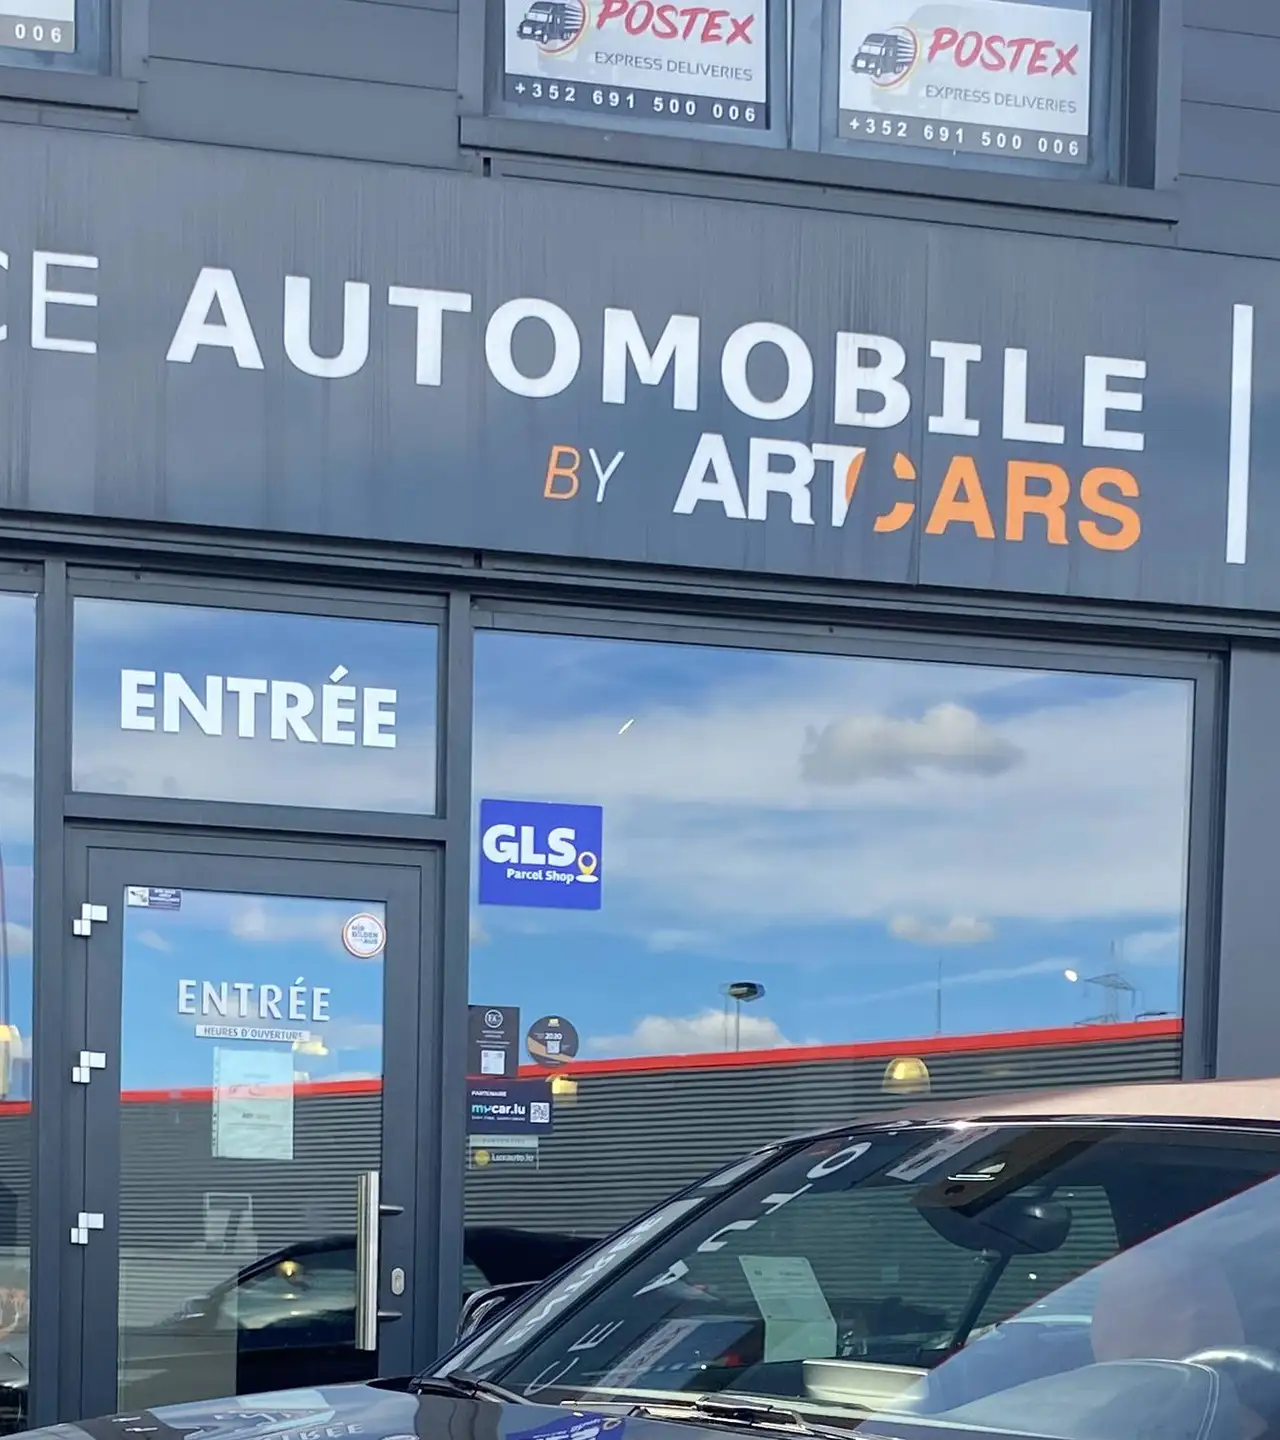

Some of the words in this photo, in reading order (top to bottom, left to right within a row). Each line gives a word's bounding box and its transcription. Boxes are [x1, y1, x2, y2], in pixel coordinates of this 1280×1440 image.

[15, 23, 61, 43] 006
[596, 0, 754, 45] POSTEX
[595, 51, 662, 71] EXPRESS
[667, 59, 753, 81] DELIVERIES
[927, 27, 1079, 77] POSTEX
[515, 82, 575, 101] +352
[593, 90, 635, 108] 691
[653, 97, 695, 115] 500
[713, 104, 755, 122] 006
[926, 84, 990, 104] EXPRESS
[995, 93, 1077, 113] DELIVERIES
[850, 118, 907, 137] +352
[924, 125, 963, 143] 691
[982, 132, 1021, 149] 500
[1038, 138, 1078, 155] 006
[166, 266, 1148, 451] AUTOMOBILE
[544, 444, 625, 504] BY
[672, 432, 1142, 552] ARTCARS
[121, 664, 397, 748] ENTRÉE
[482, 823, 577, 867] GLS
[506, 868, 543, 880] Parcel
[545, 871, 575, 884] Shop
[178, 976, 331, 1021] ENTRÉE
[204, 1027, 238, 1037] HEURES
[472, 1103, 526, 1115] mycar.lu
